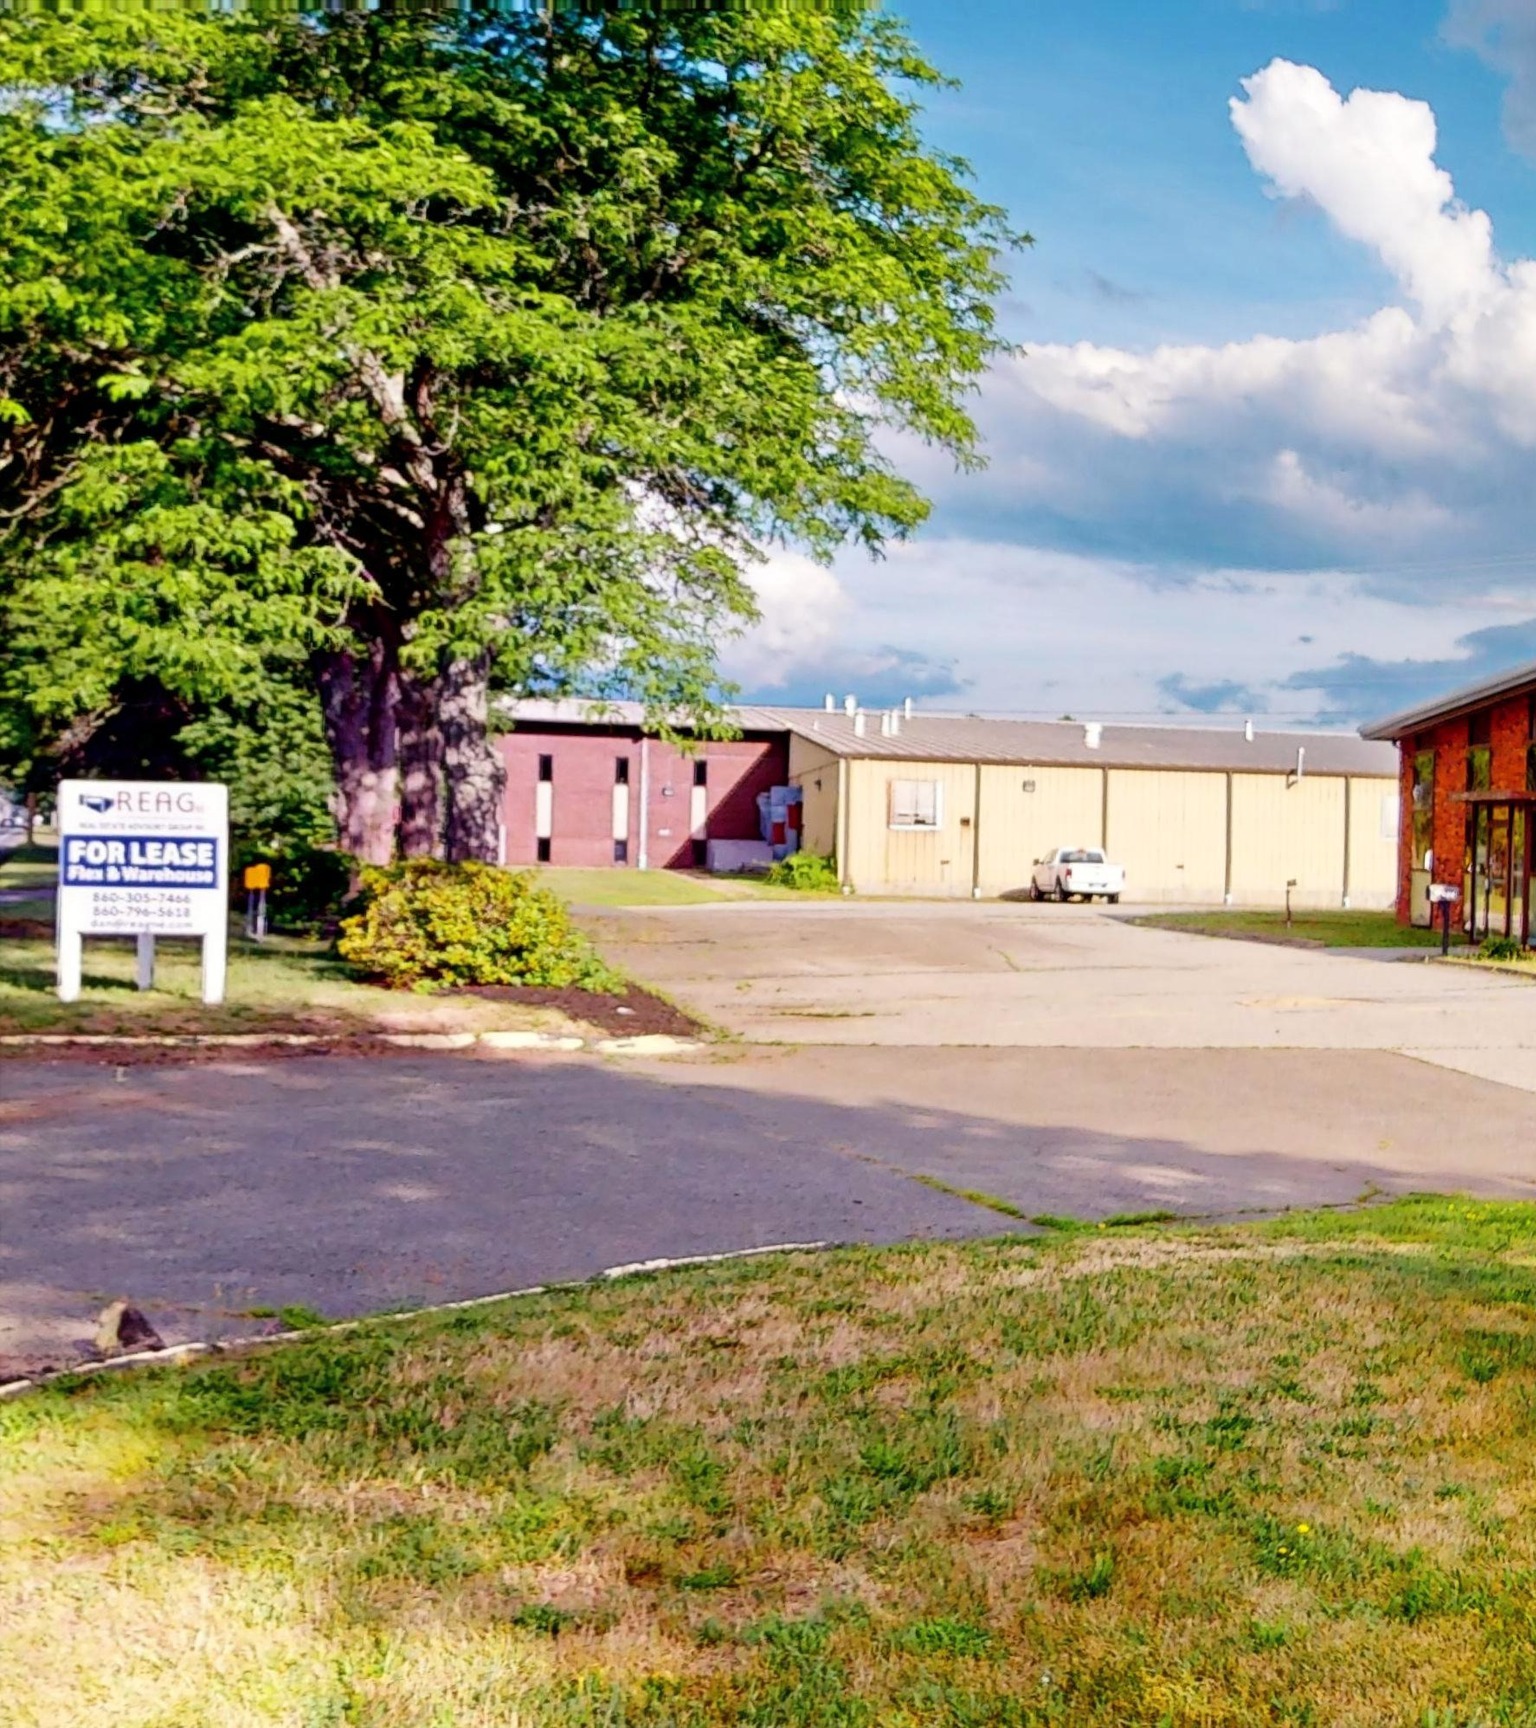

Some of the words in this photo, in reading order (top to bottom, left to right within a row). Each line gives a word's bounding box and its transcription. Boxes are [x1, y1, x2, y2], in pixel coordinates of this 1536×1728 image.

[117, 791, 195, 813] REAG
[68, 840, 126, 864] FOR
[130, 841, 214, 867] LEASE
[67, 864, 104, 882] Flex
[106, 866, 121, 882] &
[122, 866, 214, 883] Warehouse
[92, 893, 192, 904] 860-305-7466
